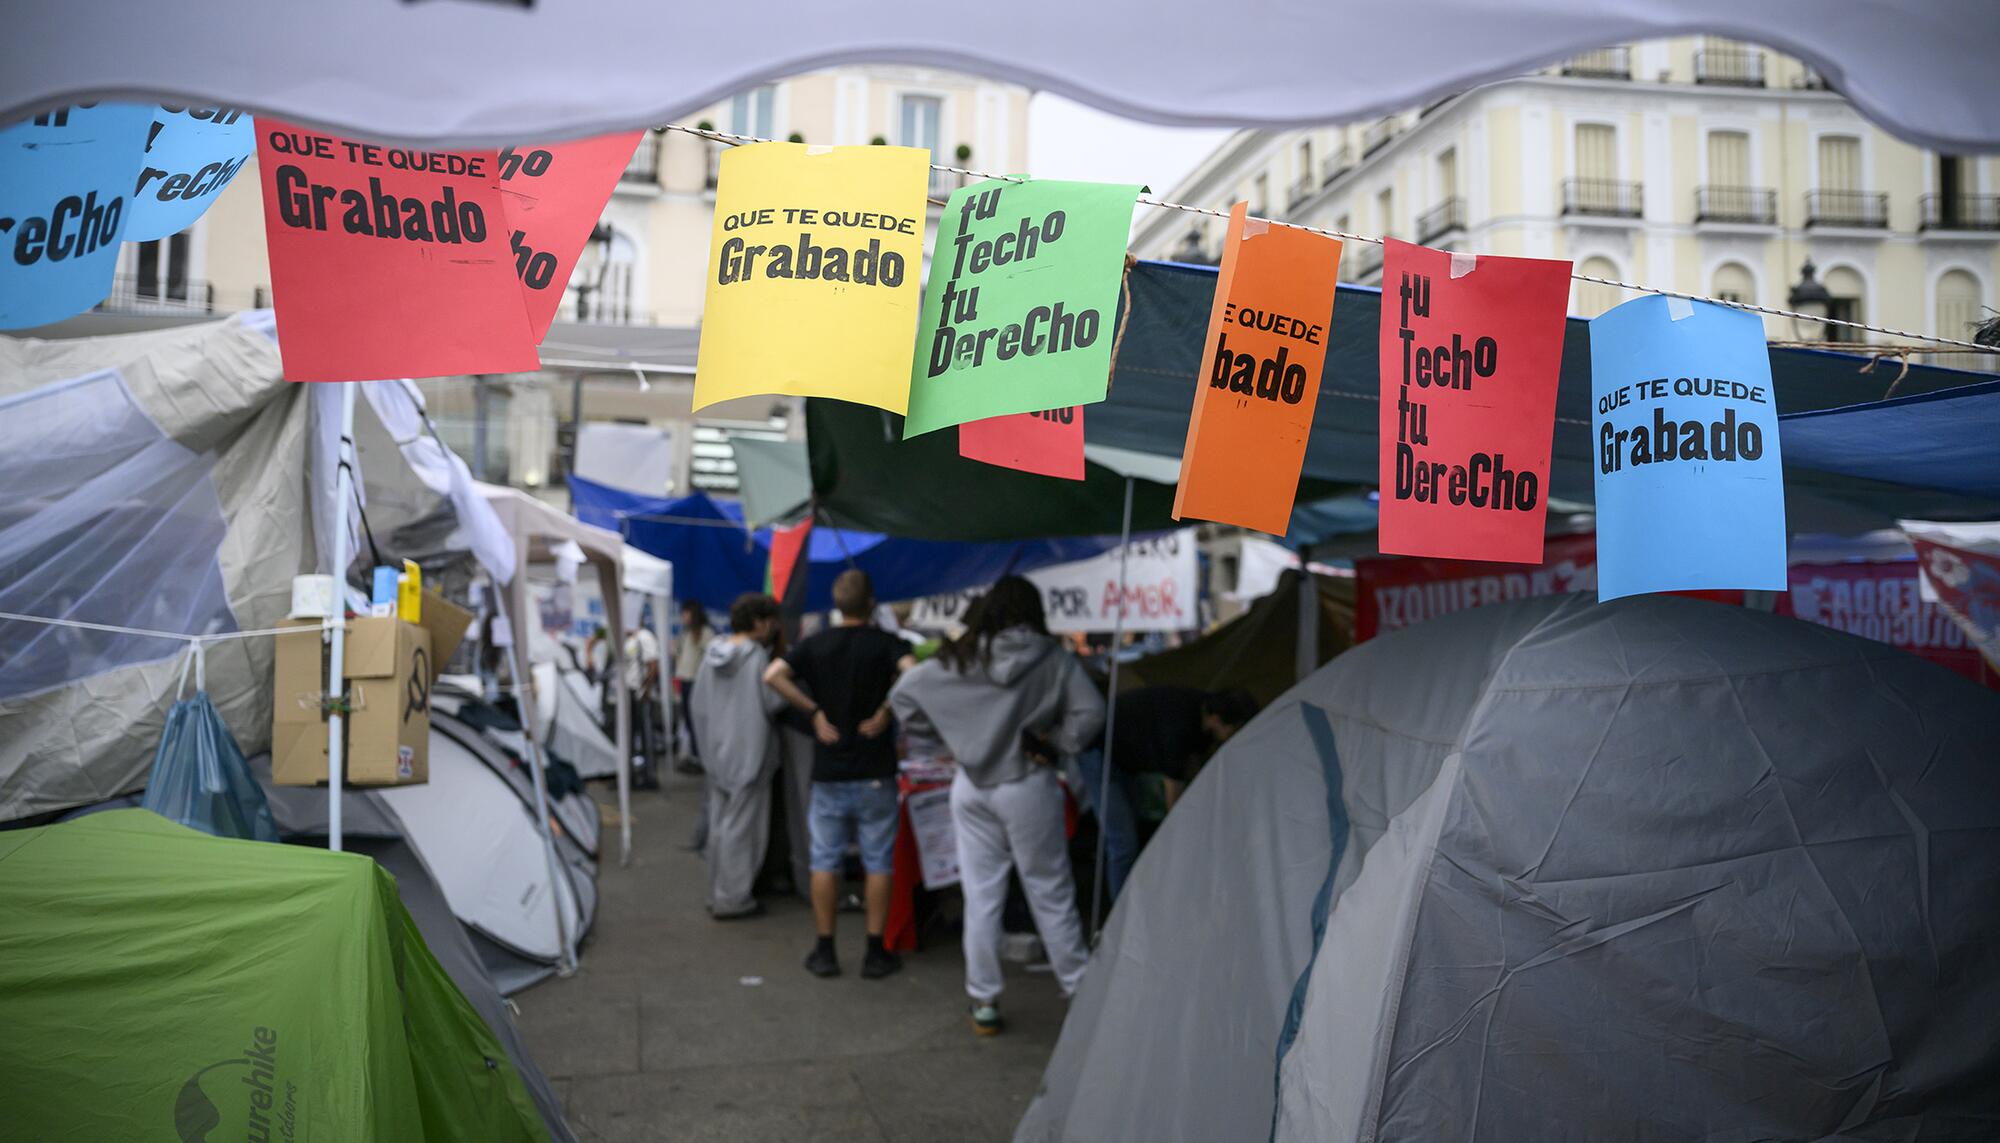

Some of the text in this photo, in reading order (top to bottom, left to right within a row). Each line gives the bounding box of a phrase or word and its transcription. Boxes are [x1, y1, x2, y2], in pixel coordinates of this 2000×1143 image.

[270, 131, 335, 160] QUE
[341, 141, 383, 167] TE
[388, 148, 486, 178] QUEDE
[276, 164, 487, 245] Grabado
[723, 208, 916, 235] QUE TE QUEDE
[957, 188, 1003, 236] tu
[718, 232, 905, 288] Grabado
[952, 210, 1067, 280] Techo
[939, 280, 978, 327] tu
[1238, 308, 1323, 345] QUEDE
[1400, 270, 1430, 329] tu
[927, 302, 1101, 379] DereCho
[1210, 332, 1307, 405] bado
[1398, 327, 1498, 391] Techo
[1398, 384, 1428, 447] tu
[1598, 377, 1767, 415] QUE TE QUEDE
[1600, 407, 1763, 475] Grabado
[1395, 442, 1539, 512] DereCho
